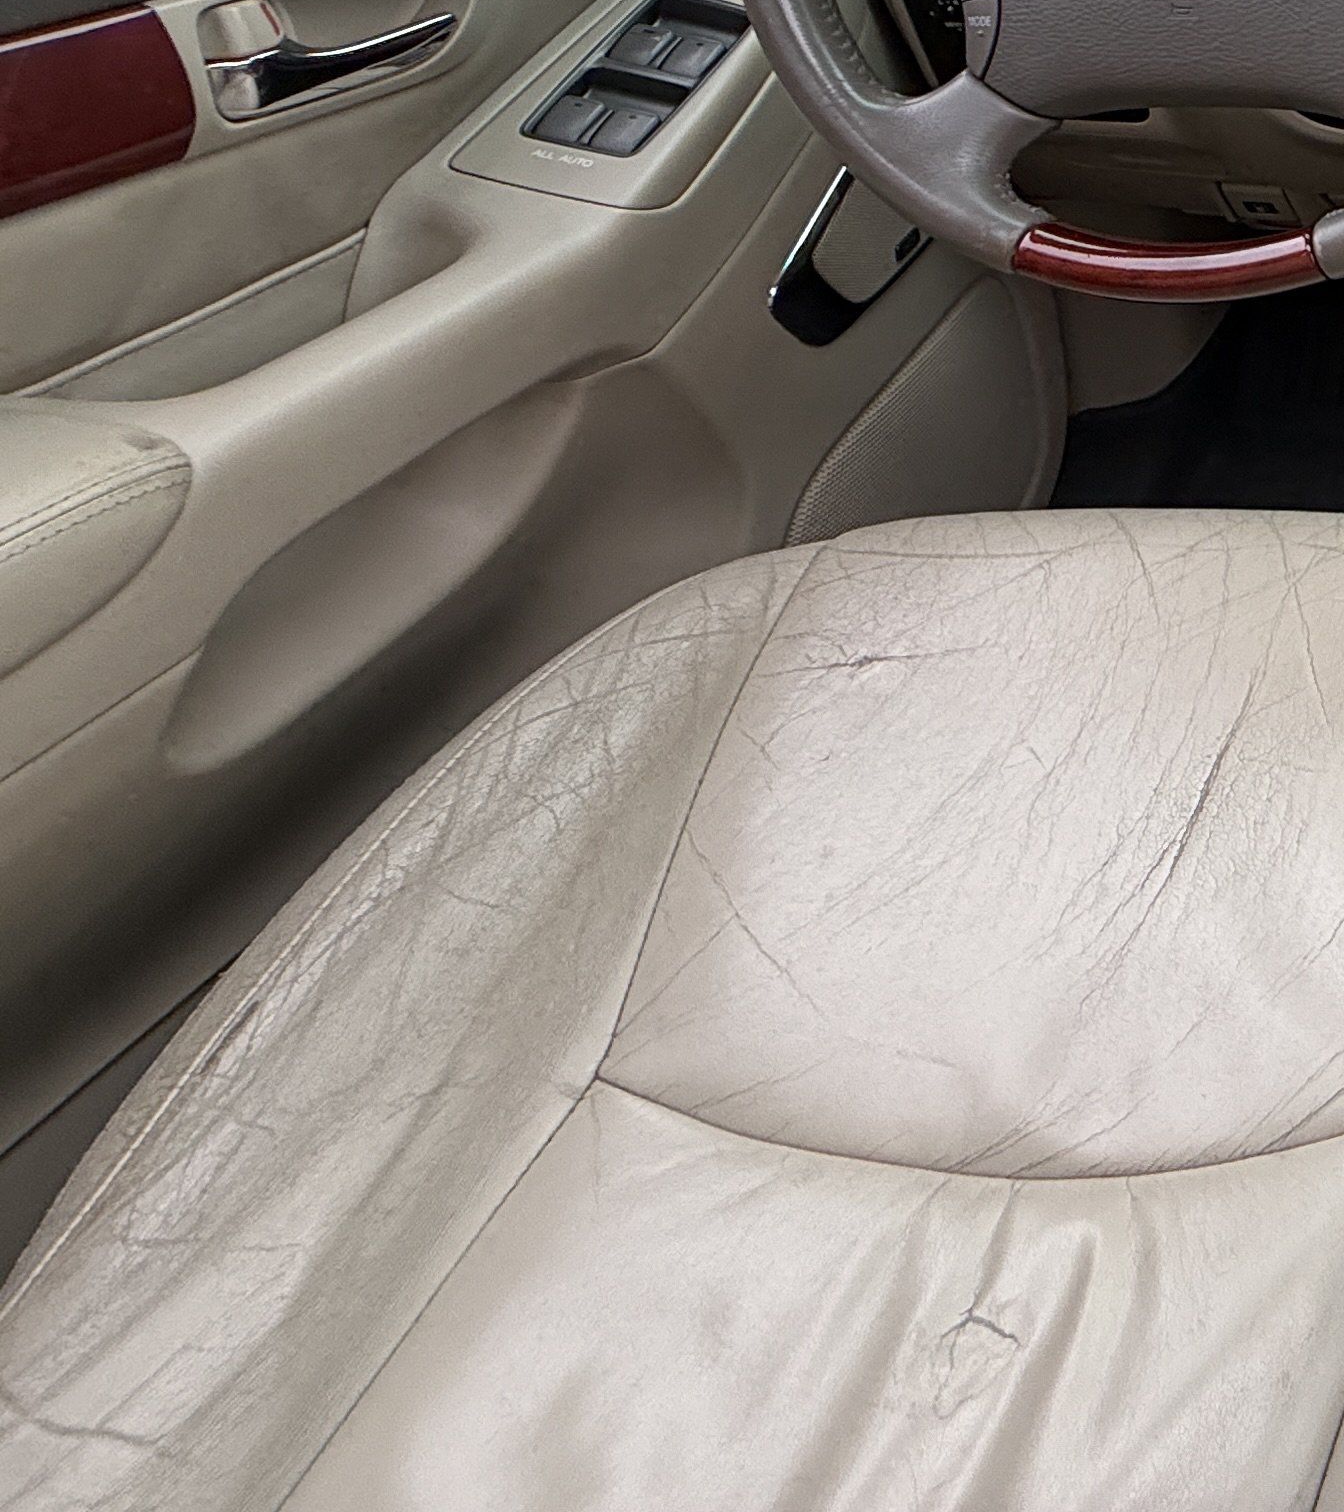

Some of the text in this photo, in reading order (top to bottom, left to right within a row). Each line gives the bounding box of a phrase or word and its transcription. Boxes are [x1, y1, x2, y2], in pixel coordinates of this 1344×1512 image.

[968, 15, 992, 27] MODE
[530, 149, 595, 169] ALL AUTO
